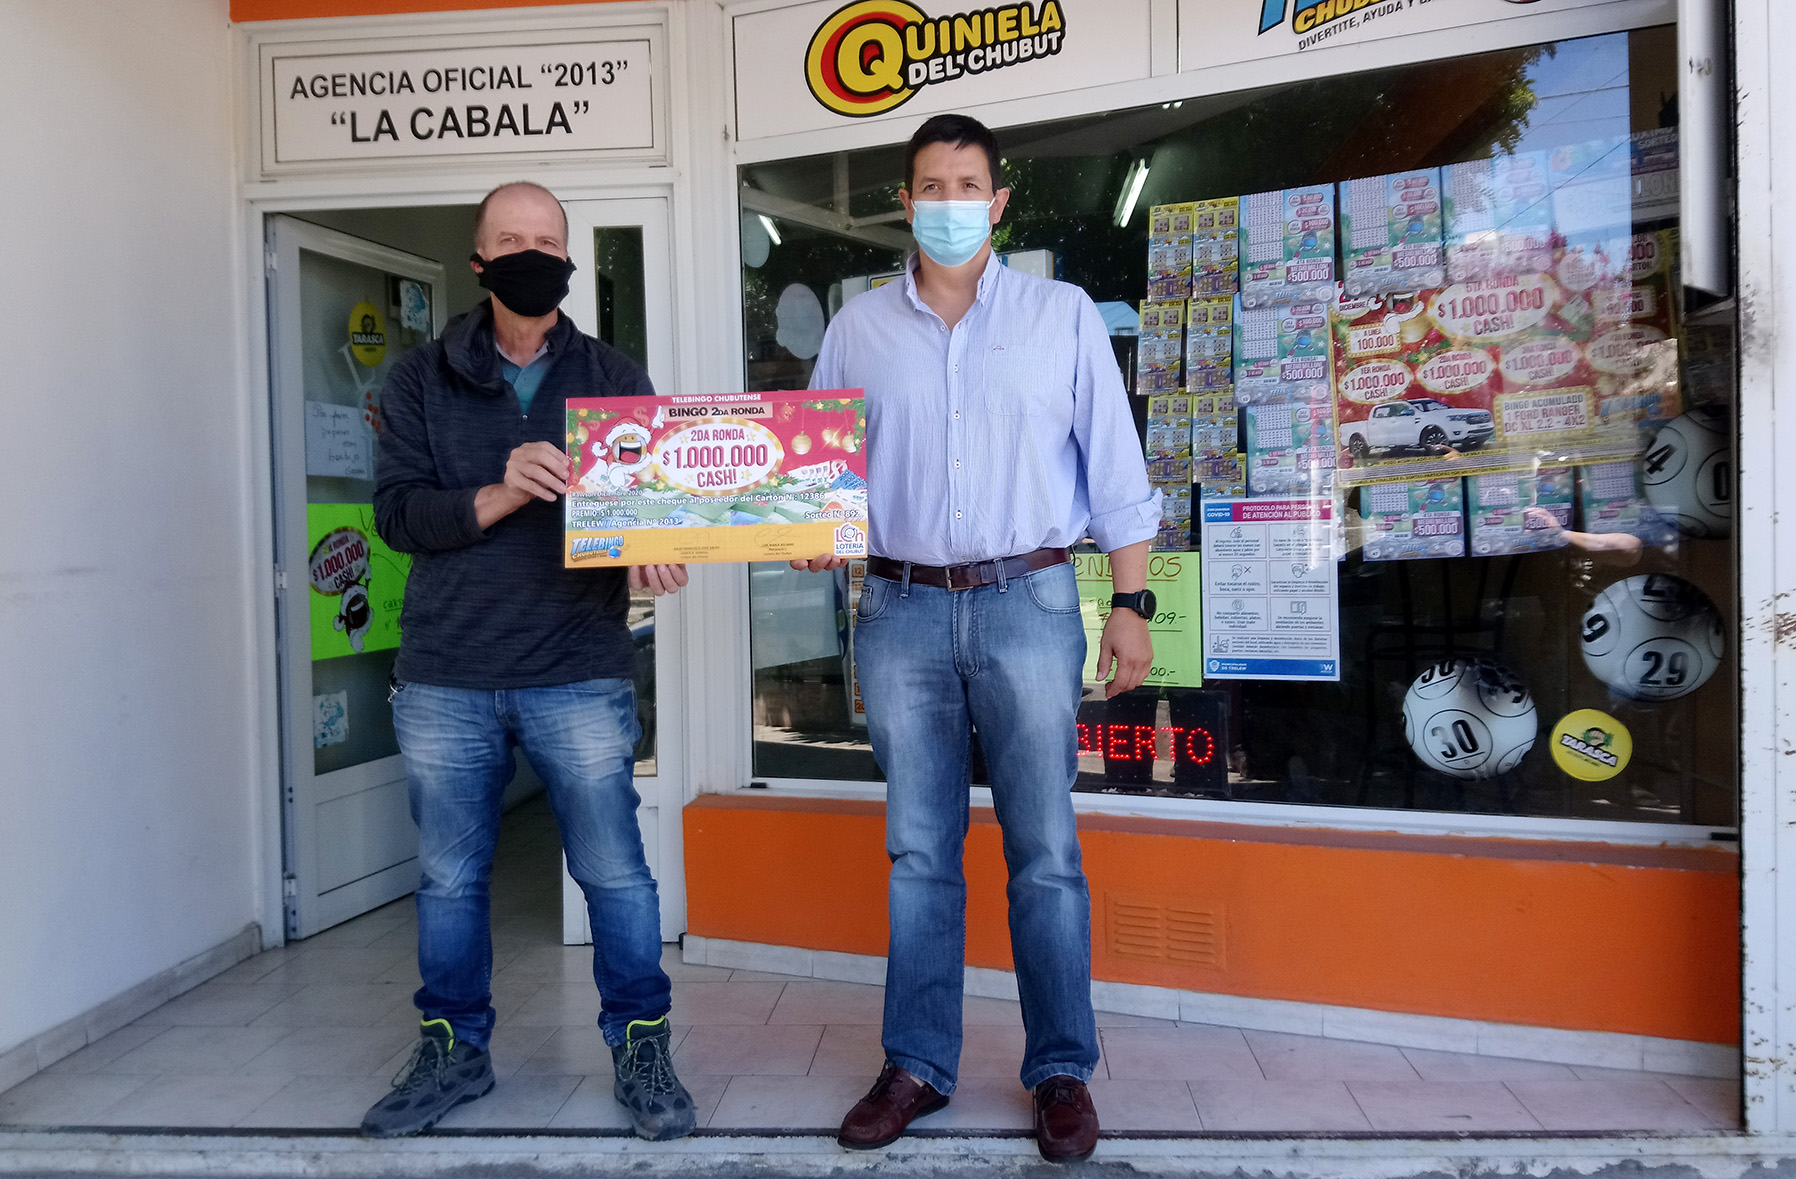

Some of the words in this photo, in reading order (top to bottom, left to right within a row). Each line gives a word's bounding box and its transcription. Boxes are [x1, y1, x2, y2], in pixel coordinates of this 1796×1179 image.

[1298, 17, 1360, 50] DIVERTITE,
[1363, 4, 1403, 22] AYUDA
[838, 2, 1061, 93] QUINIELA
[967, 32, 1062, 70] CHUBUT
[290, 71, 414, 99] AGENCIA
[422, 65, 532, 93] OFICIAL
[1394, 254, 1438, 268] $500.000
[1288, 269, 1329, 282] $500.000
[1485, 276, 1519, 290] RONDA
[1339, 301, 1367, 311] DICIEMBRE
[1438, 304, 1446, 318] $
[1449, 287, 1544, 320] 1.000.000
[1473, 314, 1515, 335] CASH!
[1357, 335, 1394, 350] 100.000
[1452, 352, 1473, 361] RONDA
[1512, 350, 1573, 371] 1.000.000
[1282, 367, 1323, 380] $500.000
[1372, 364, 1392, 373] RONDA
[1423, 369, 1429, 379] $
[1430, 360, 1487, 380] 1.000.000
[1528, 369, 1555, 381] CASH!
[1344, 381, 1350, 390] $
[1351, 372, 1405, 390] 1.000.000
[1444, 377, 1468, 389] CASH!
[672, 395, 712, 404] TELEBINGO
[714, 394, 761, 403] CHUBUTENSE
[1364, 389, 1388, 400] CASH!
[1504, 401, 1529, 411] BINGO
[1532, 394, 1583, 408] ACUMULADO
[669, 407, 708, 418] BINGO
[711, 407, 729, 416] 2DA
[731, 407, 765, 416] RONDA
[1514, 409, 1539, 420] FORD
[1542, 405, 1580, 417] RANGER
[1505, 422, 1518, 433] DC
[1520, 421, 1534, 431] XL
[1537, 418, 1554, 429] 2.2
[1564, 414, 1586, 427] 4X2
[691, 429, 710, 441] 2DA
[713, 428, 745, 441] RONDA
[662, 450, 671, 466] $
[674, 444, 768, 469] 1.000.000
[697, 469, 738, 488] CASH!
[571, 500, 619, 509] Entreguese
[621, 500, 636, 508] por
[657, 498, 687, 507] cheque
[699, 496, 738, 505] poseedor
[800, 493, 826, 501] 12386
[571, 509, 599, 518] PREMIO:
[804, 511, 831, 520] Sorteo
[571, 520, 604, 529] TRELEW
[611, 519, 644, 529] Agencia
[659, 518, 679, 526] 2013
[1414, 522, 1458, 535] $500.000
[571, 535, 624, 555] TELEBINGO
[318, 540, 364, 581] 1.000.000
[1639, 651, 1689, 685] 29
[1076, 723, 1215, 765] BIERTO
[1431, 719, 1479, 759] 30
[1561, 735, 1617, 767] TARASCA
